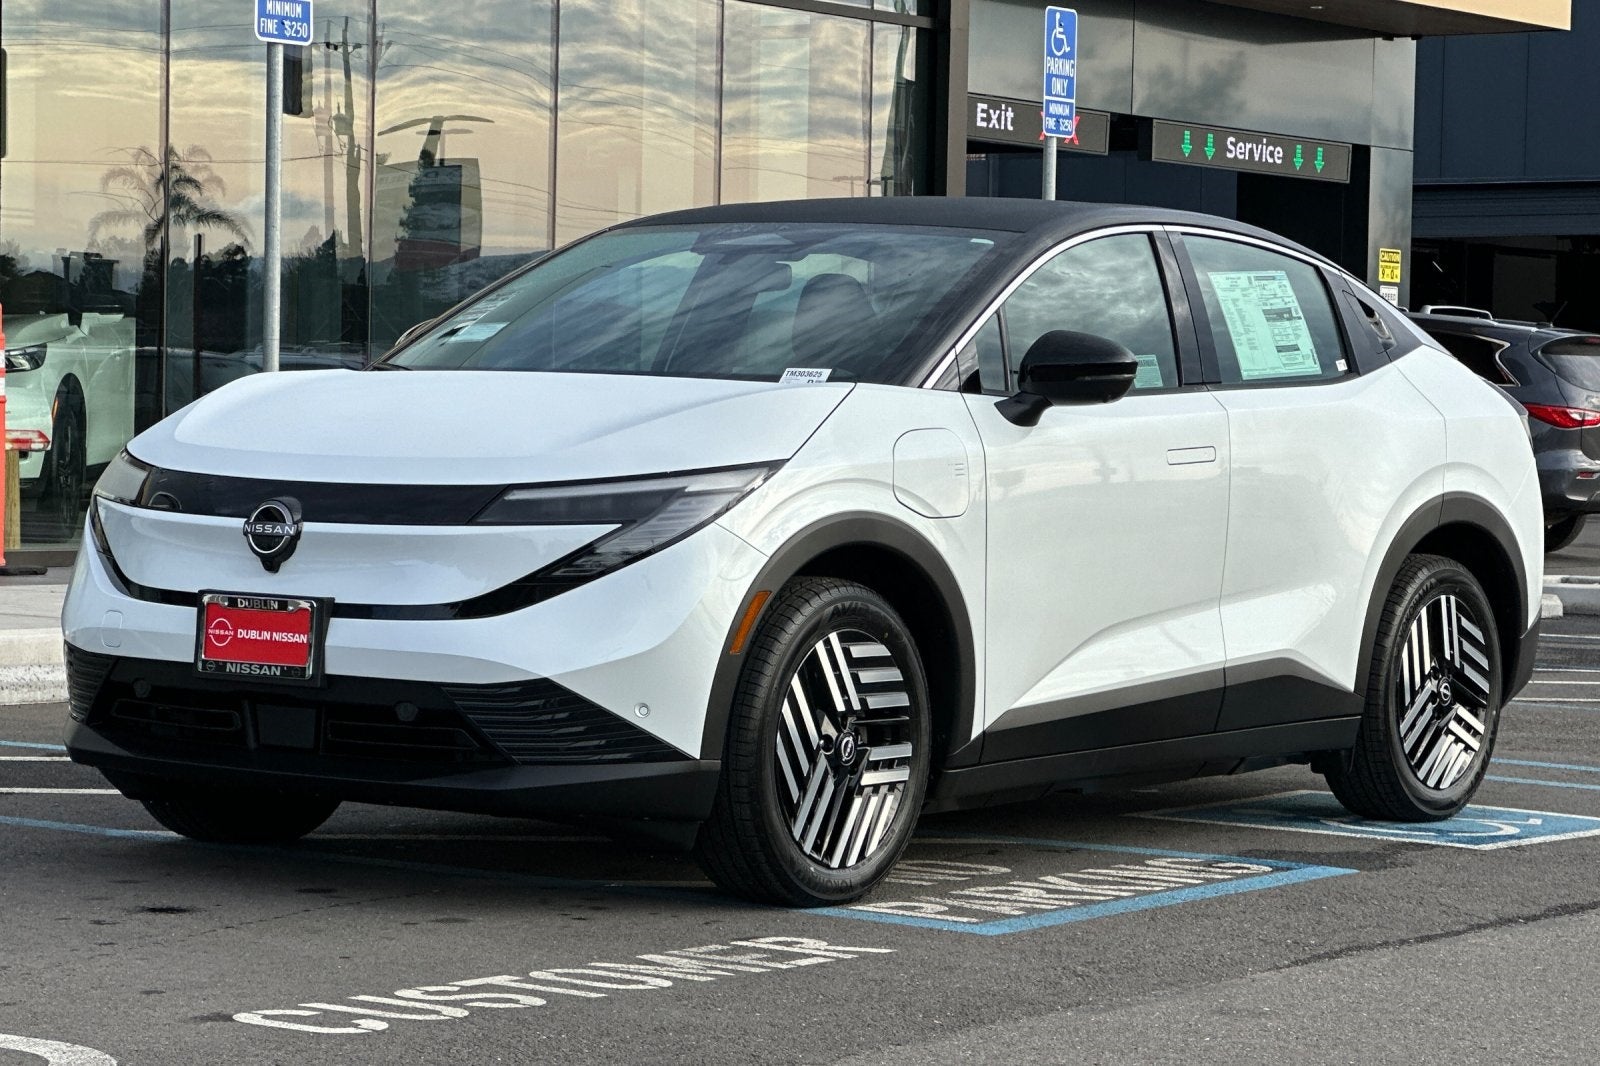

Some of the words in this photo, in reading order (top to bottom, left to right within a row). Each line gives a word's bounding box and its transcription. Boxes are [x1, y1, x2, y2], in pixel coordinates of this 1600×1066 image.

[266, 0, 302, 18] MINIMUM
[260, 17, 278, 34] FINE
[283, 19, 308, 38] $250
[1046, 57, 1074, 77] PARKING
[1051, 77, 1068, 96] ONLY
[976, 103, 1014, 131] Exit
[1048, 102, 1070, 116] MINIMUM
[1045, 117, 1057, 130] FINE
[1060, 119, 1072, 132] $250
[1226, 136, 1284, 164] Service
[785, 370, 823, 378] TM303625
[244, 523, 296, 535] NISSAN
[237, 598, 279, 610] DUBLIN
[208, 628, 234, 637] NISSAN
[237, 628, 271, 640] DUBLIN
[272, 630, 308, 644] NISSAN
[225, 662, 281, 676] NISSAN
[848, 857, 1274, 924] PARKING
[232, 936, 895, 1035] CUSTOMER
